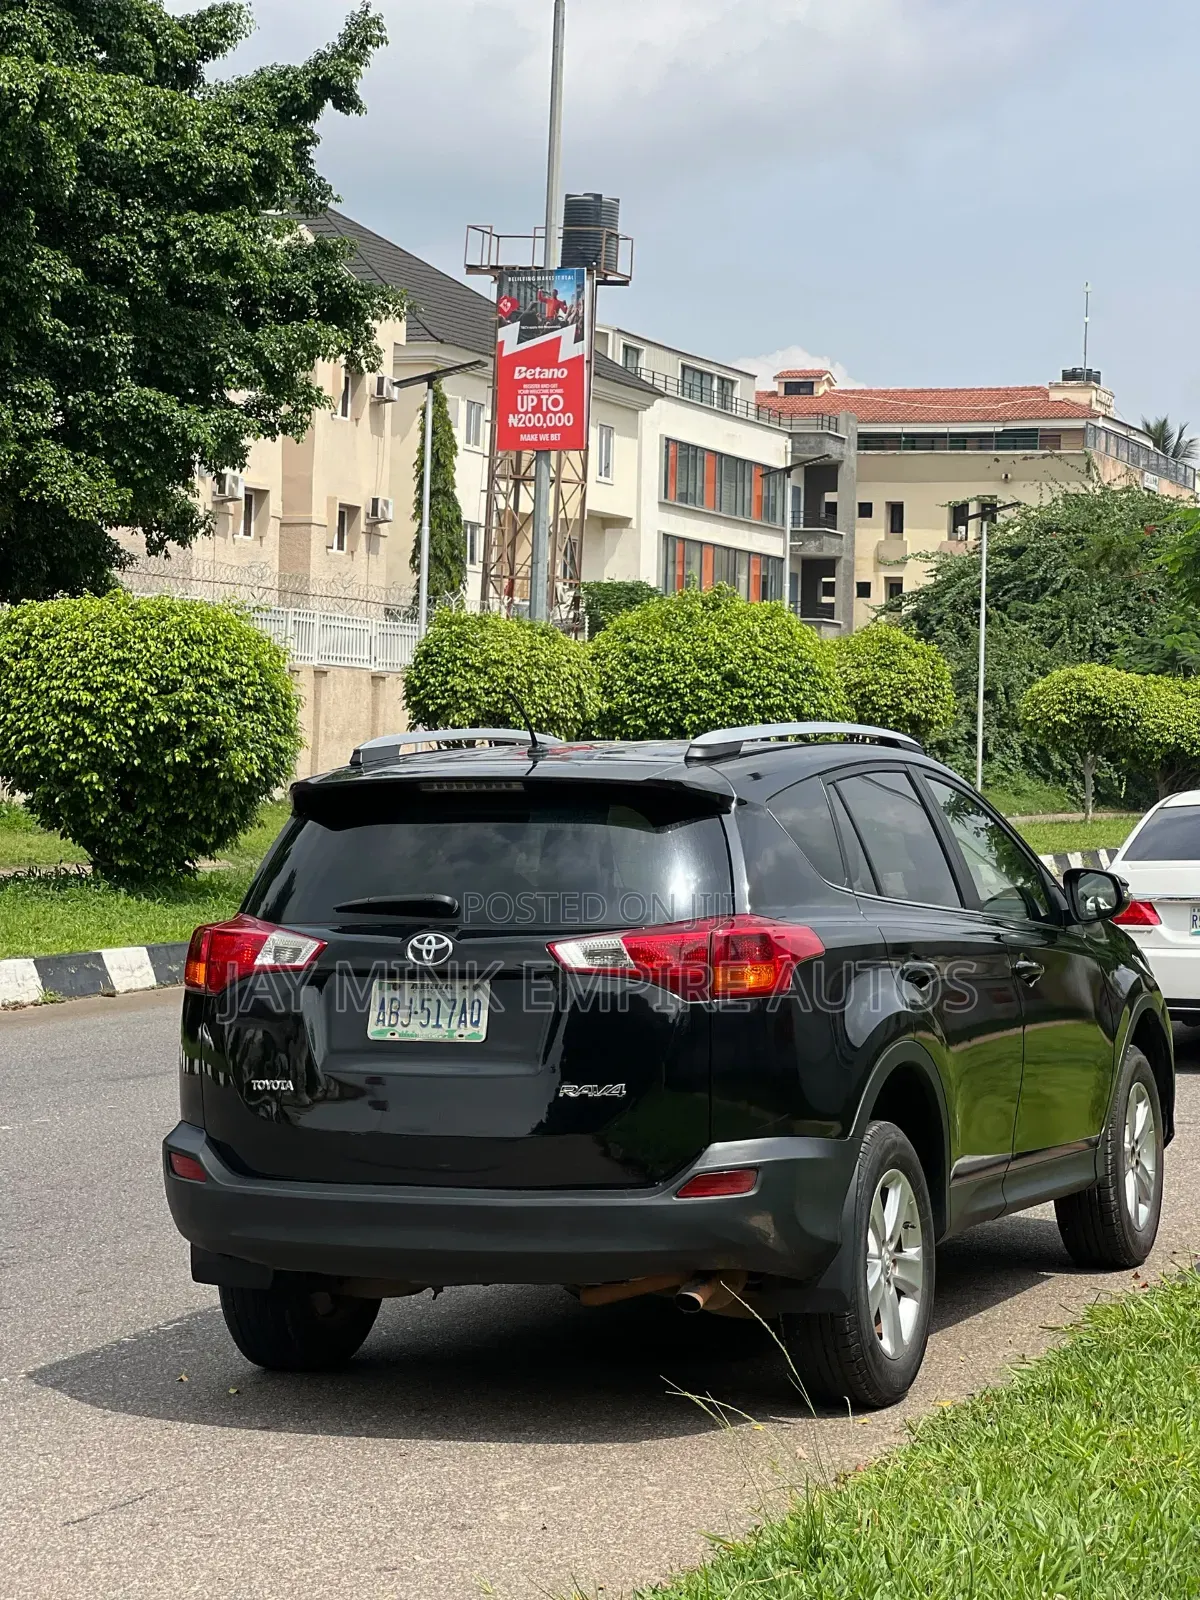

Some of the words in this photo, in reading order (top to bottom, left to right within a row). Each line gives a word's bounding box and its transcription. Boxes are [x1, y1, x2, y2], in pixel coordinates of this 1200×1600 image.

[513, 366, 568, 380] Betano
[517, 395, 538, 412] UP
[540, 394, 564, 412] TO
[520, 433, 538, 441] MAKE
[539, 433, 549, 441] WE
[550, 433, 561, 441] BET
[251, 1079, 294, 1091] TOYOTA
[559, 1083, 627, 1097] RAV4
